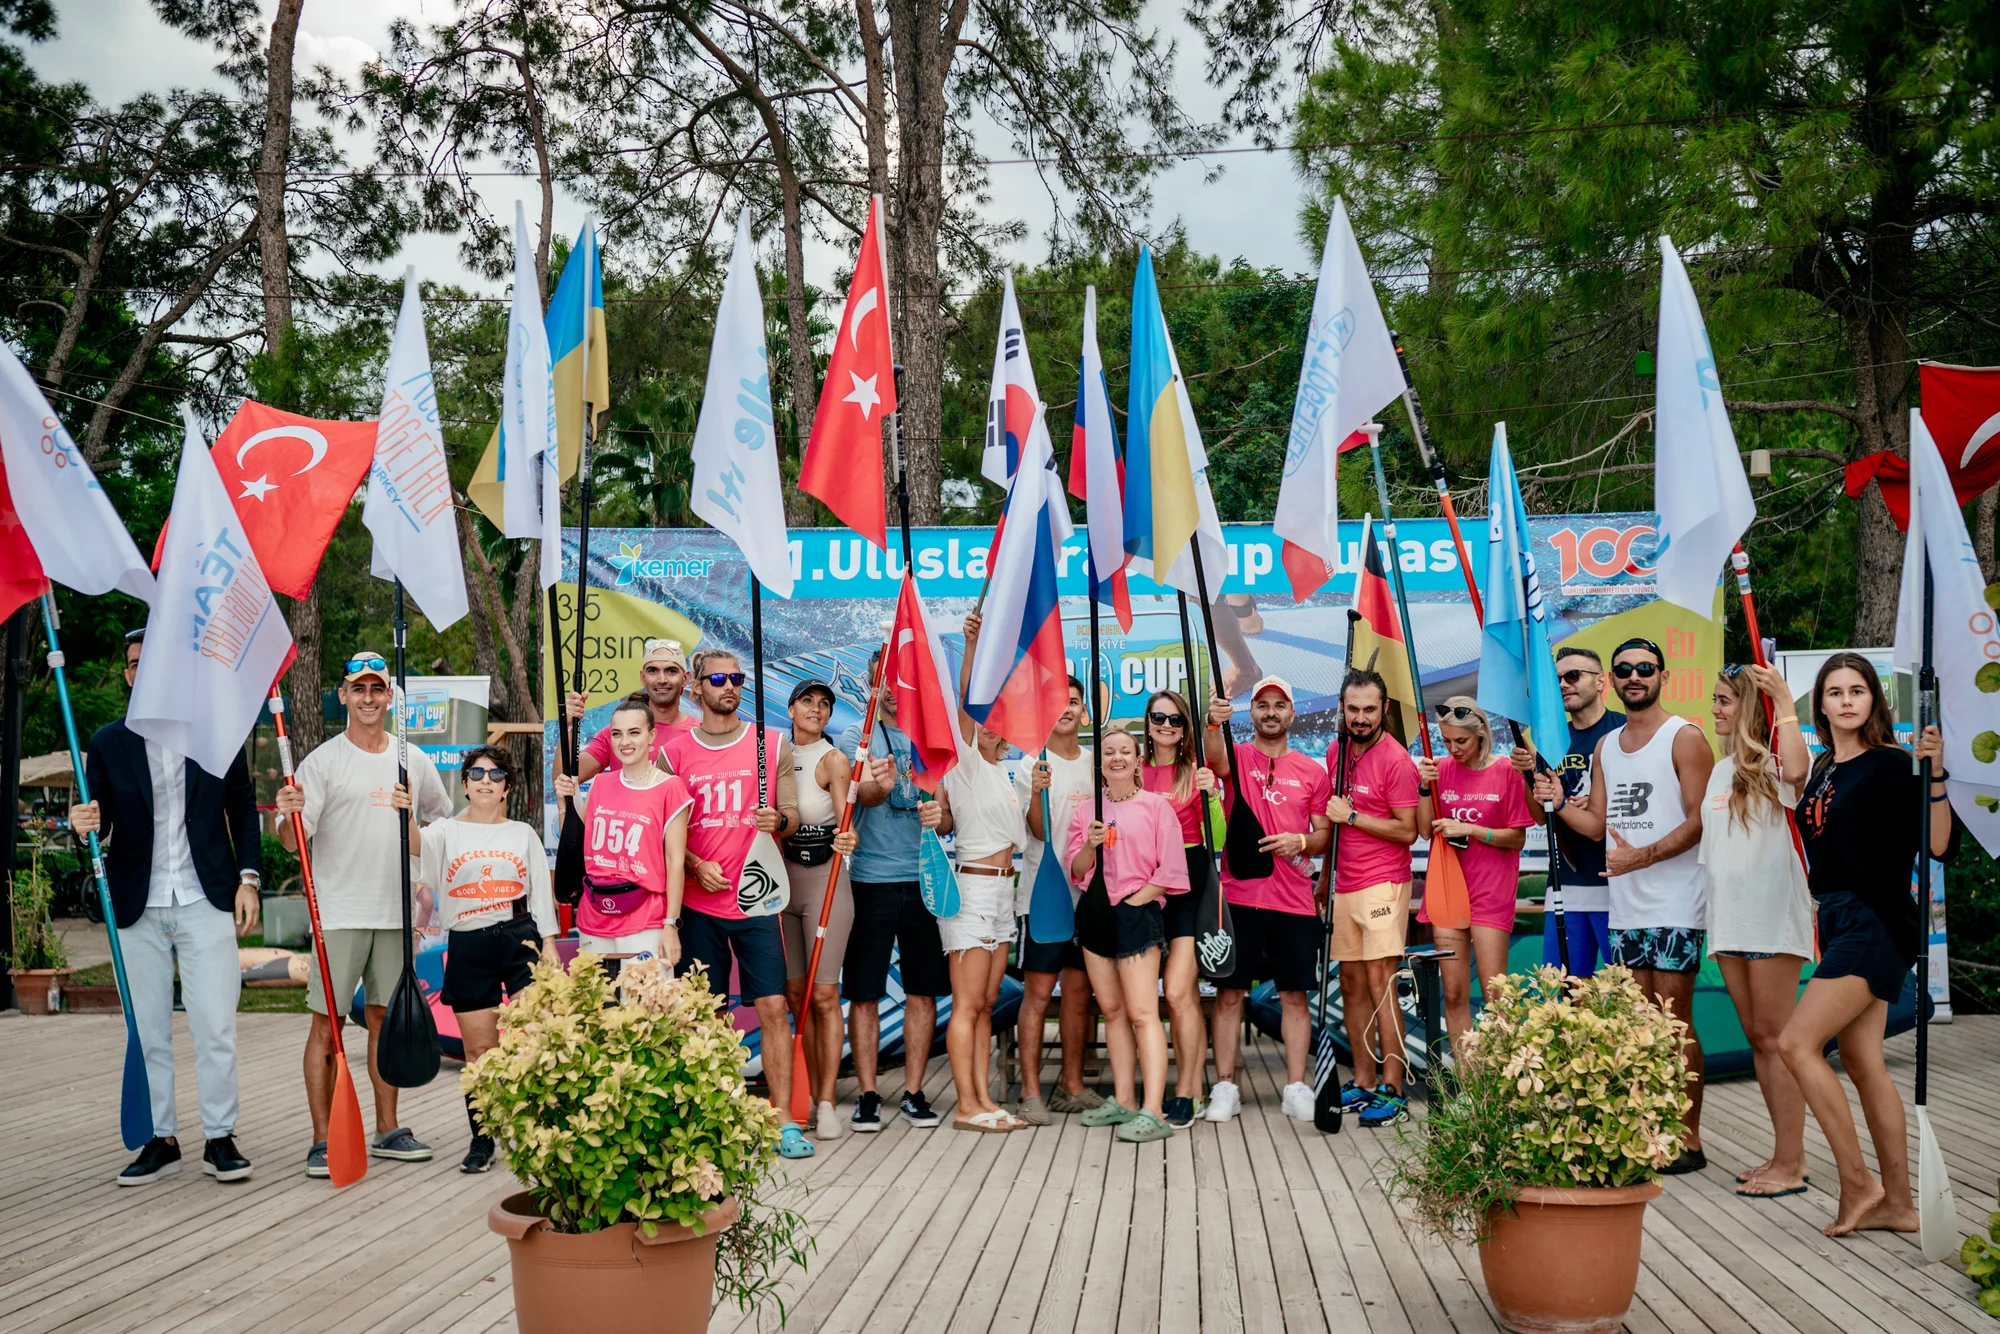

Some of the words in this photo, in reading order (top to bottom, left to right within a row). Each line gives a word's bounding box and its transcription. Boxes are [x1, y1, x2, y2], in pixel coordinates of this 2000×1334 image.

[635, 558, 714, 578] kemer
[1227, 542, 1273, 585] up
[1073, 637, 1127, 650] TÜKİYE
[1666, 627, 1695, 658] En
[1120, 657, 1188, 695] CUP
[698, 779, 742, 814] 111
[591, 816, 644, 857] 054
[456, 888, 477, 896] GOOD
[493, 885, 516, 893] VIBES
[923, 872, 936, 911] HAUTE
